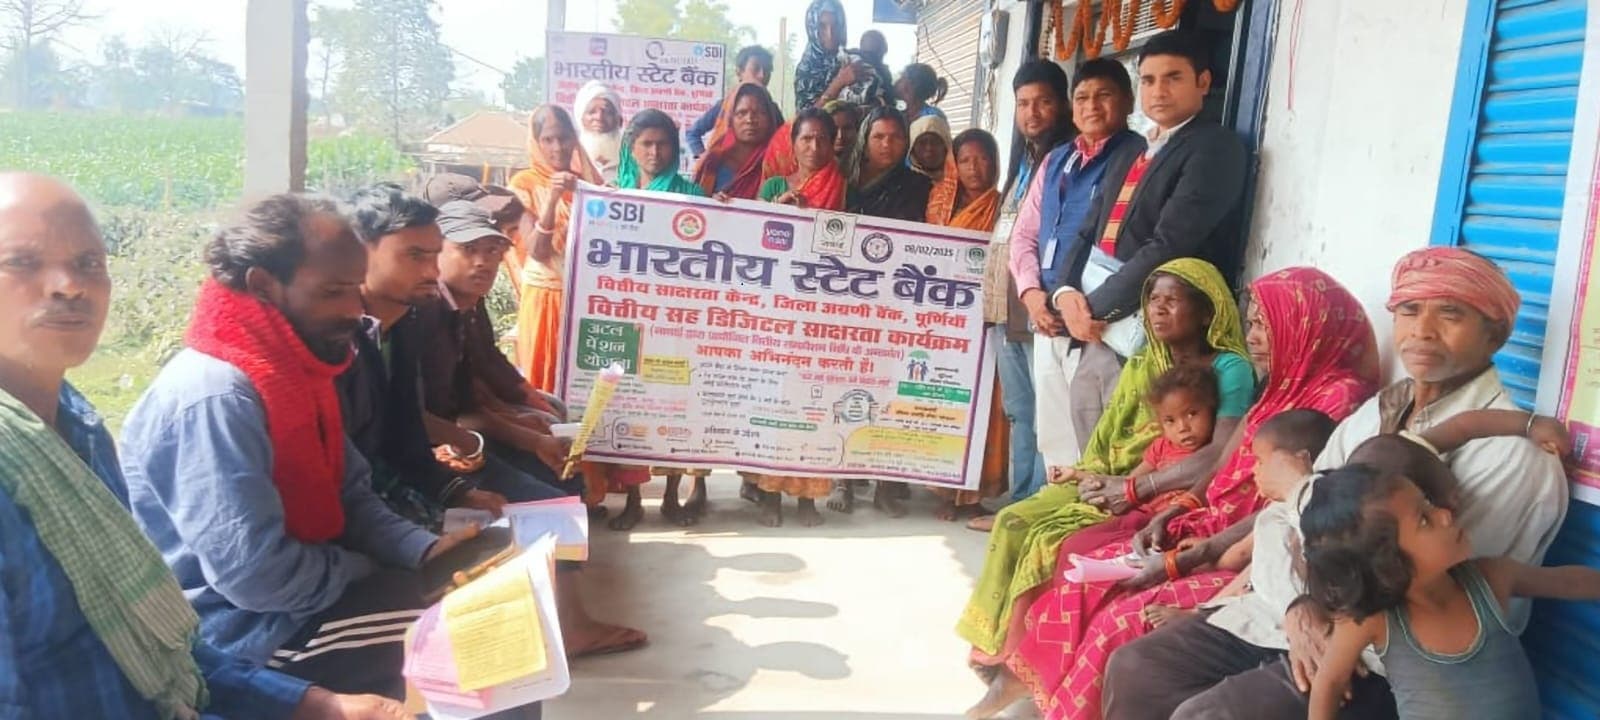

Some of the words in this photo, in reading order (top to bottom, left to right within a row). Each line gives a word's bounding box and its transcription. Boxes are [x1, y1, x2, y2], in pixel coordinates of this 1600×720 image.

[554, 60, 632, 81] भारतीय
[637, 63, 677, 83] स्टेट
[681, 66, 718, 87] बैंक
[608, 202, 645, 224] SBI
[587, 239, 779, 288] भारतीय
[790, 256, 885, 298] स्टेट
[893, 264, 981, 308] बैंक
[597, 275, 650, 294] वित्तीय
[655, 284, 719, 301] साक्षरता
[774, 294, 817, 312] जिला
[821, 302, 872, 318] अग्रणी
[587, 323, 624, 336] अटल
[588, 295, 657, 321] वित्तीय
[664, 306, 702, 324] सह
[707, 307, 797, 335] डिजिटल
[802, 321, 882, 343] साक्षरता
[888, 329, 971, 353] कार्यक्रम
[697, 345, 743, 358] आपका
[751, 350, 811, 368] अभिनंदन
[818, 357, 854, 371] करती
